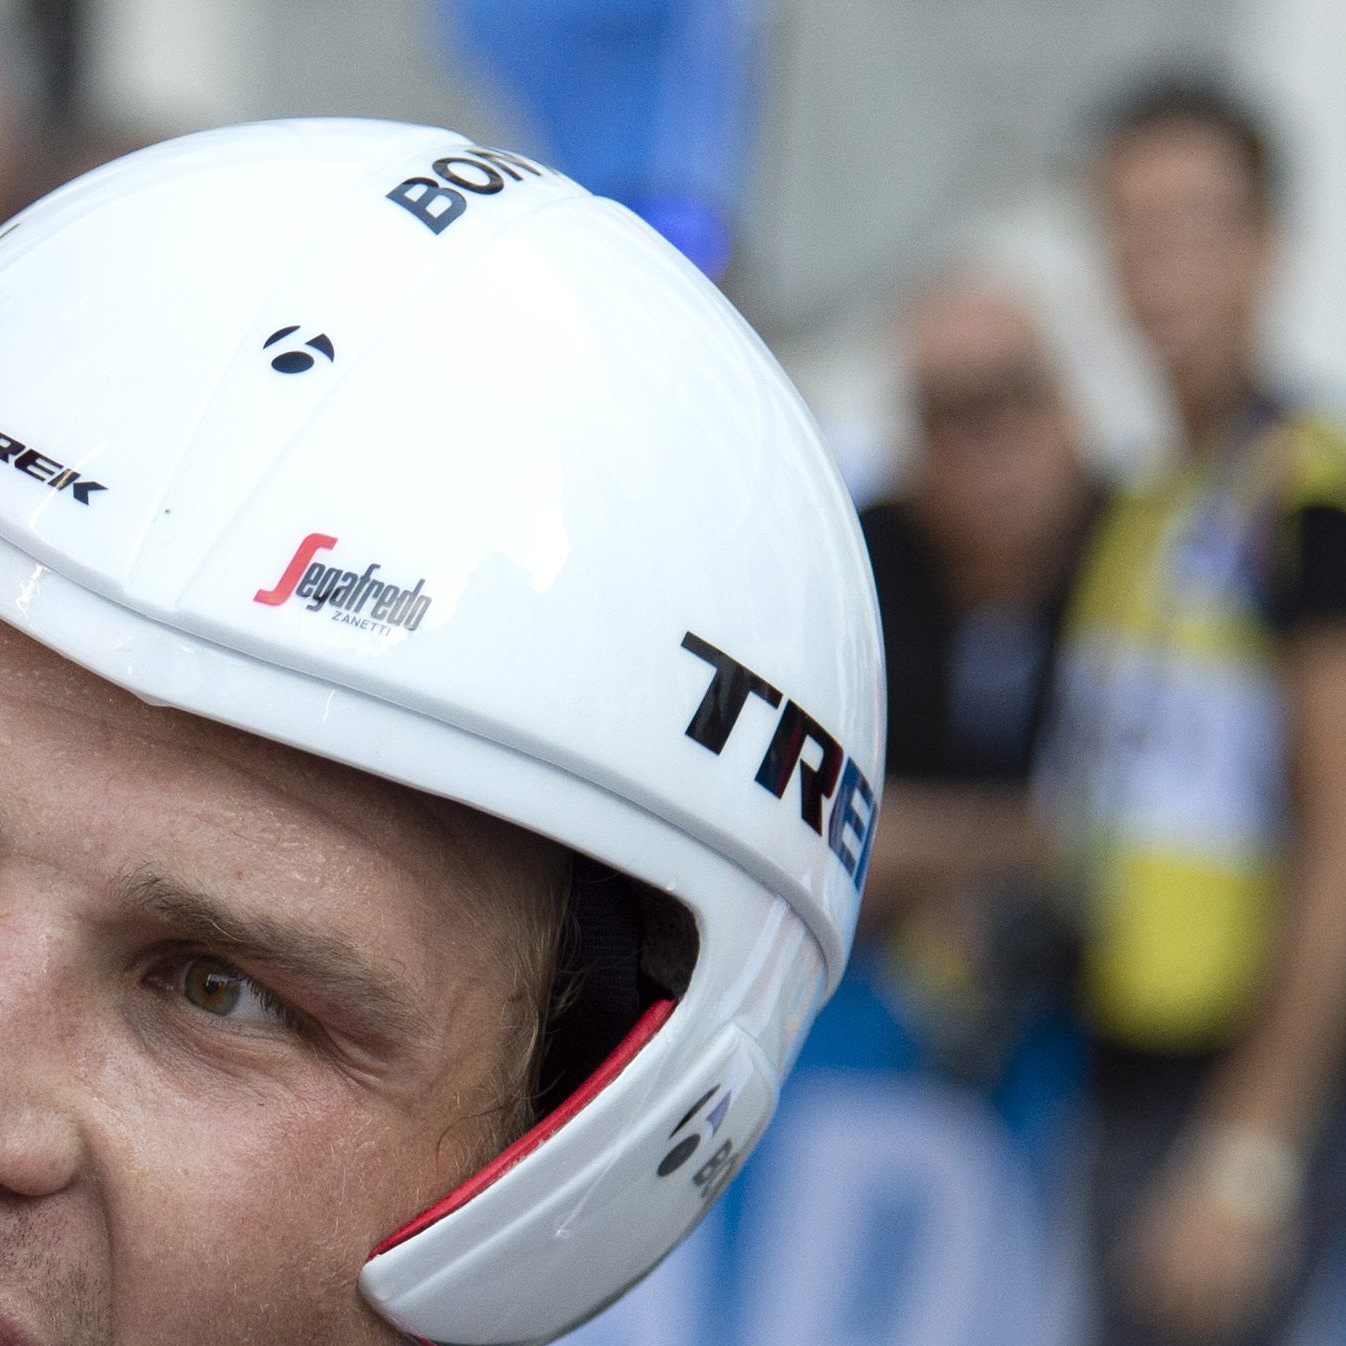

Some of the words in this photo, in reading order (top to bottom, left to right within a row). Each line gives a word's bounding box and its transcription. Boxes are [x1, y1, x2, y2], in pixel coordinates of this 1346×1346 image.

[385, 147, 556, 235] BON
[252, 532, 432, 632] Segafredo
[331, 610, 392, 637] ZANETTI
